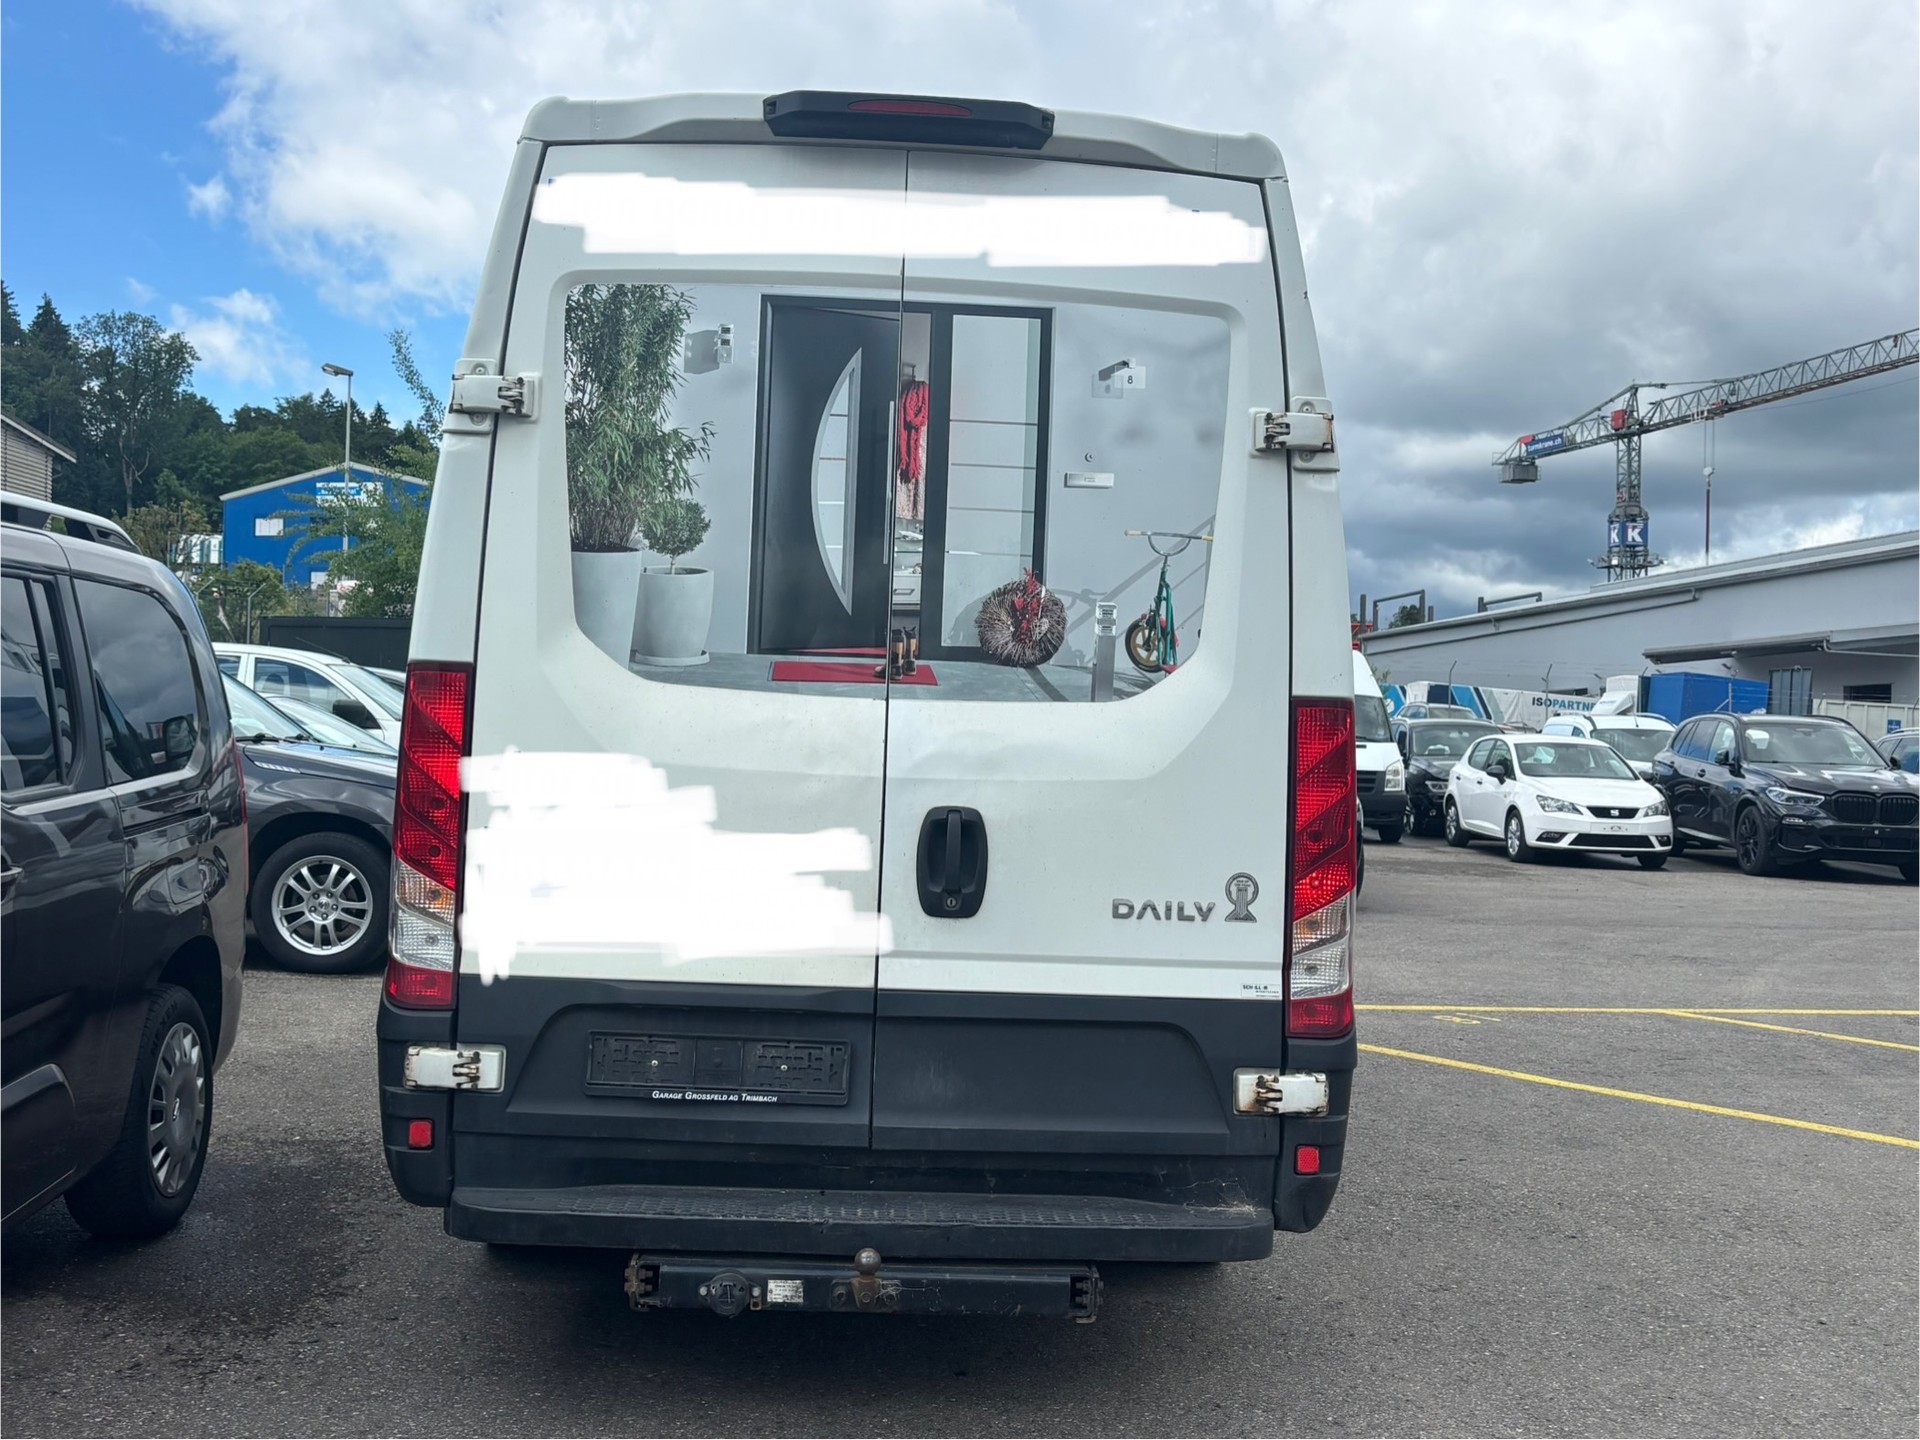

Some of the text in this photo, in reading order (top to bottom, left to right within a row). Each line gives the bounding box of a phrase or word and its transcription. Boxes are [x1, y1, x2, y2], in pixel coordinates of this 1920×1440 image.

[1127, 375, 1134, 385] 8
[1627, 525, 1643, 542] K
[1112, 898, 1215, 922] DAILY
[652, 1090, 778, 1103] GARAGE GROSSFELD AG TRIMBACH
